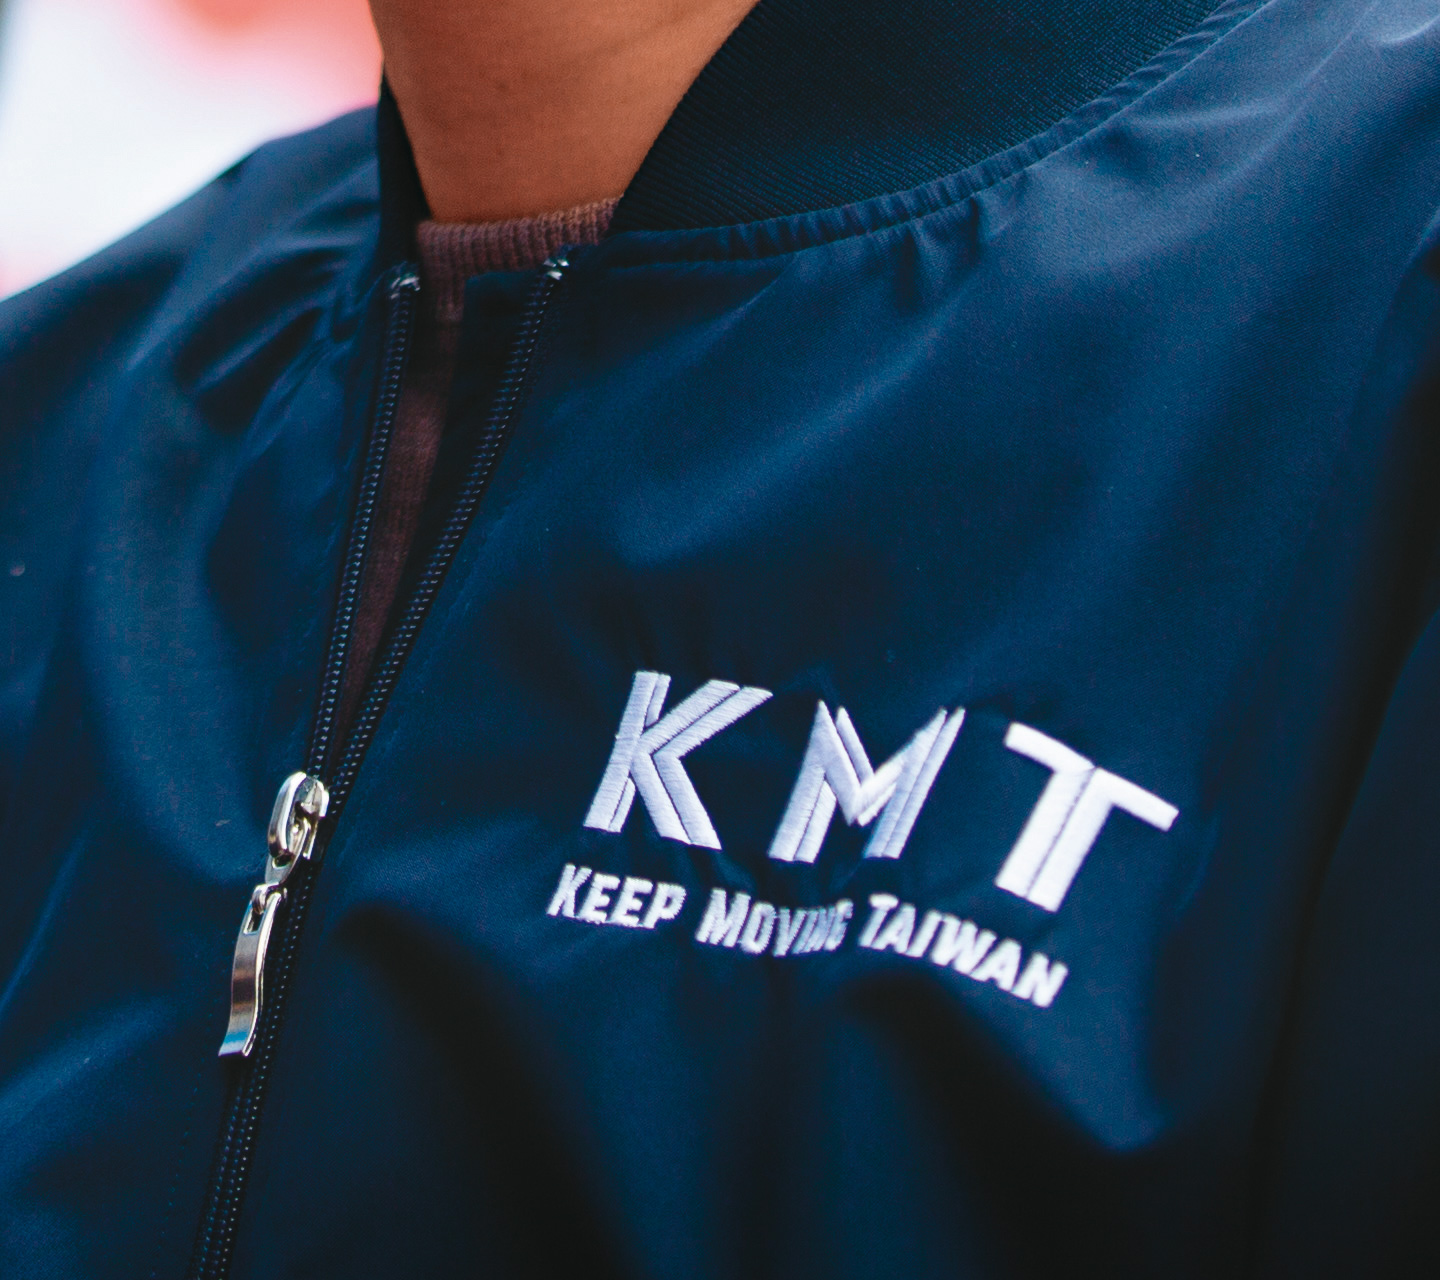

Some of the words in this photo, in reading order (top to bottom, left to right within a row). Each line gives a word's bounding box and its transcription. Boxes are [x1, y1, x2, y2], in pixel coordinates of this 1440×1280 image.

[583, 670, 1180, 913] KMT
[546, 863, 687, 930] KEEP
[695, 888, 853, 957] MOVING
[859, 894, 1069, 1008] TAIWAN
